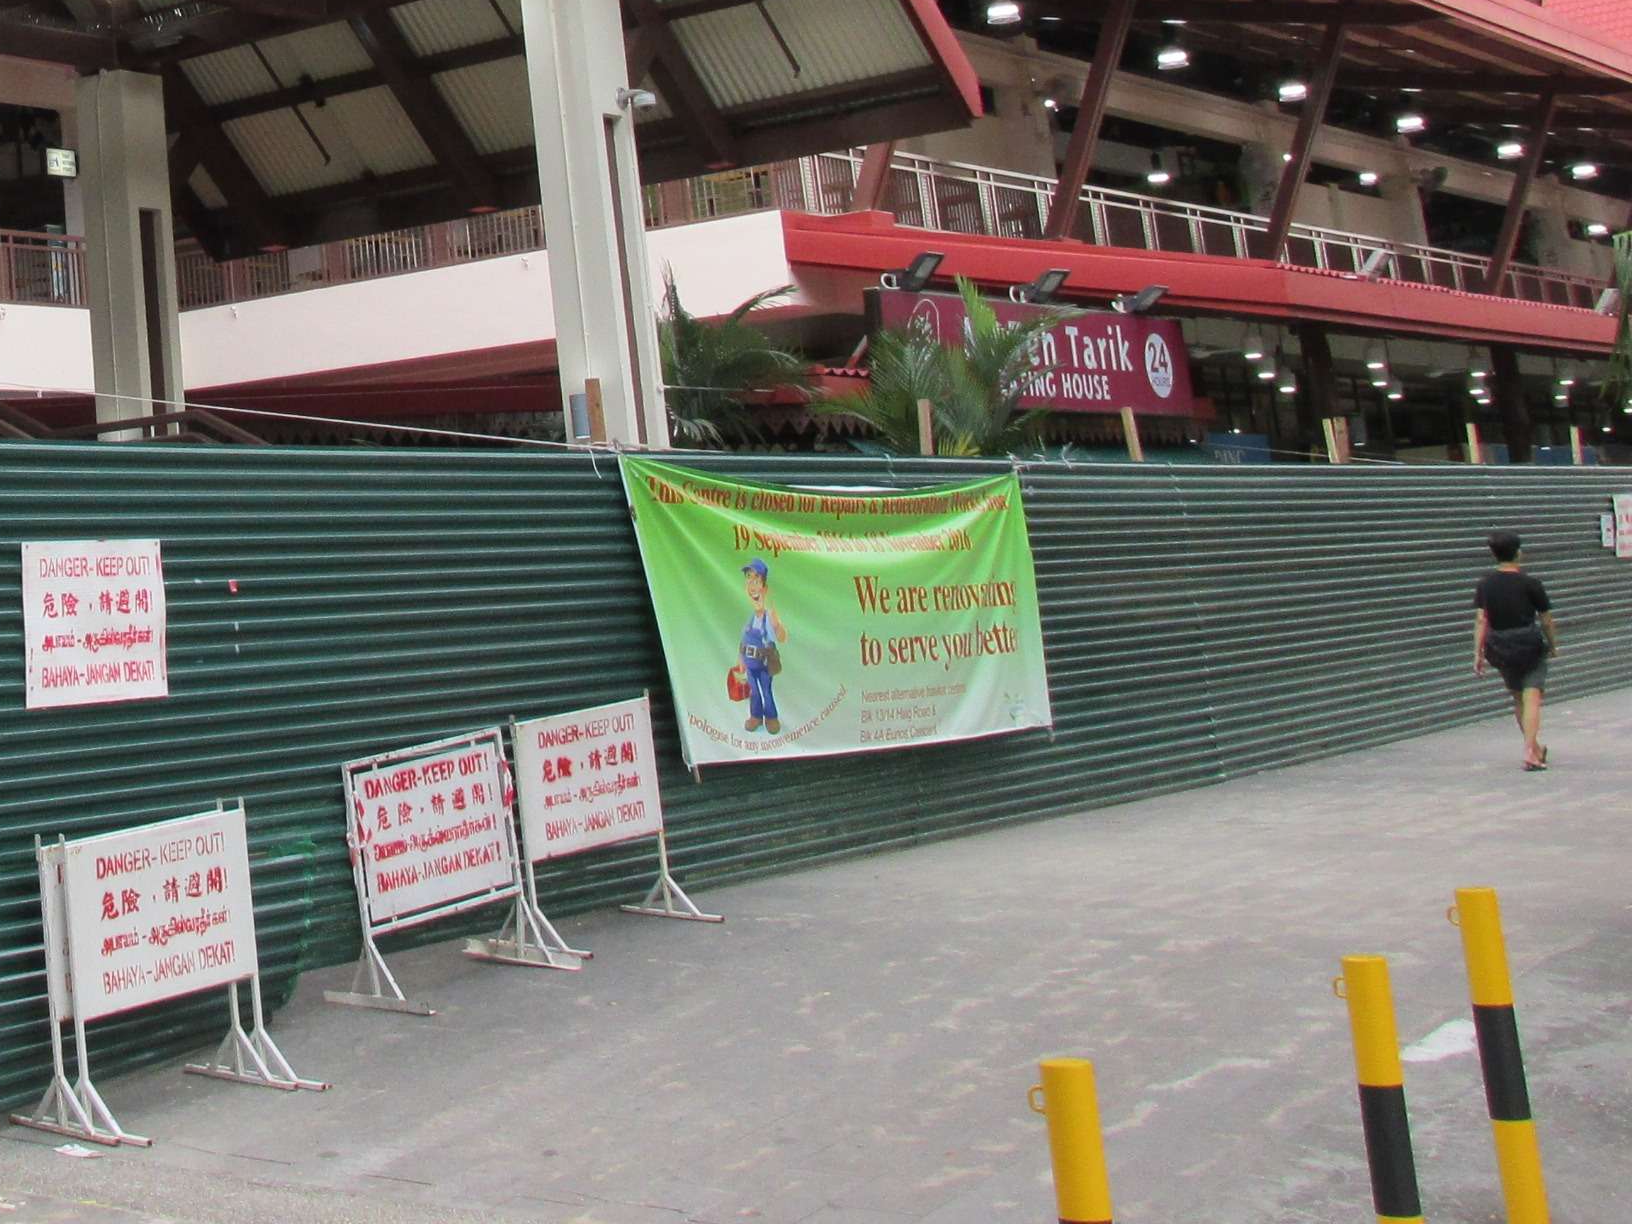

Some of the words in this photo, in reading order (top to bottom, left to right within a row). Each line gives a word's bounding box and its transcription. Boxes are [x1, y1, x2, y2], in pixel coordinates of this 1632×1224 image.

[1065, 324, 1133, 372] Tarik
[1148, 342, 1168, 373] 24
[1063, 372, 1111, 400] HOUSE
[736, 485, 747, 511] is
[752, 488, 794, 512] closed
[733, 524, 750, 551] 19
[947, 527, 973, 552] 2016
[96, 556, 123, 576] KEEP
[853, 575, 890, 615] We
[896, 585, 928, 614] are
[860, 631, 882, 666] to
[888, 634, 938, 665] serve
[942, 631, 973, 671] you
[585, 719, 610, 740] KEEP
[458, 752, 489, 777] OUT!
[160, 839, 193, 865] KEEP
[196, 831, 225, 857] OUT!
